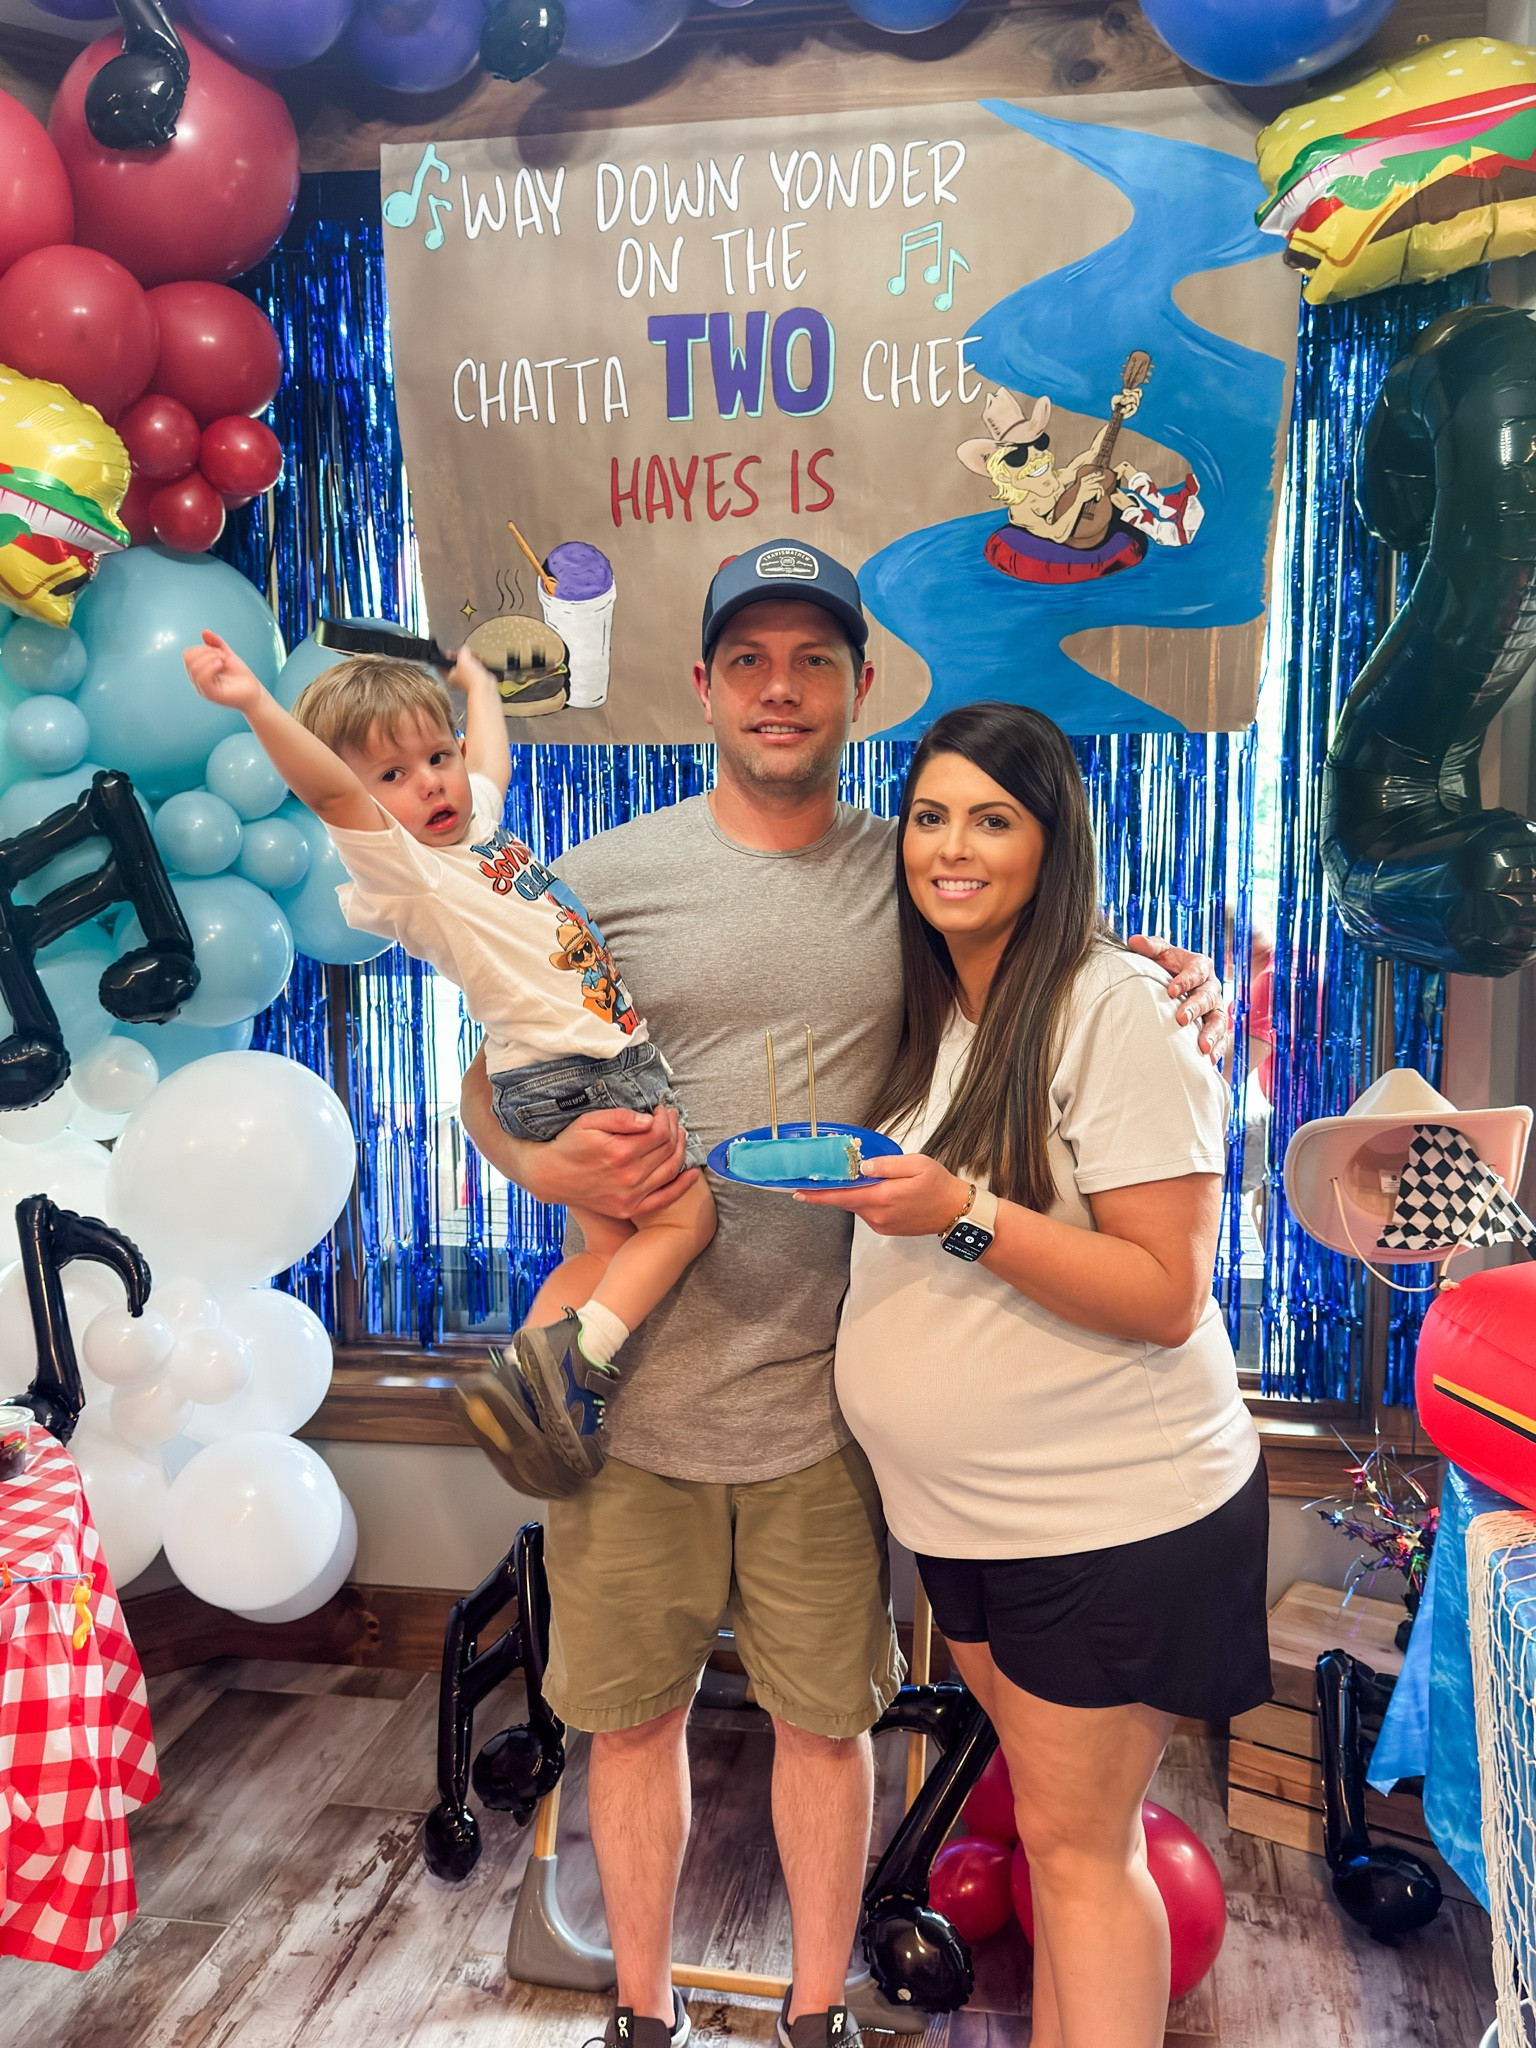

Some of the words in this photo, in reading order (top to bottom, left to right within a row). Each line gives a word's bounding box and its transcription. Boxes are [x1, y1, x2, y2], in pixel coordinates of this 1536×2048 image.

[461, 166, 565, 240] WAY
[597, 155, 746, 233] DOWN
[769, 140, 966, 213] YONDER
[617, 236, 685, 299] ON
[712, 222, 808, 295] THE
[453, 356, 630, 428] CHATTA
[647, 307, 836, 420] TWO
[862, 336, 984, 408] CHEE
[611, 453, 762, 527] HAYES
[790, 448, 834, 514] IS
